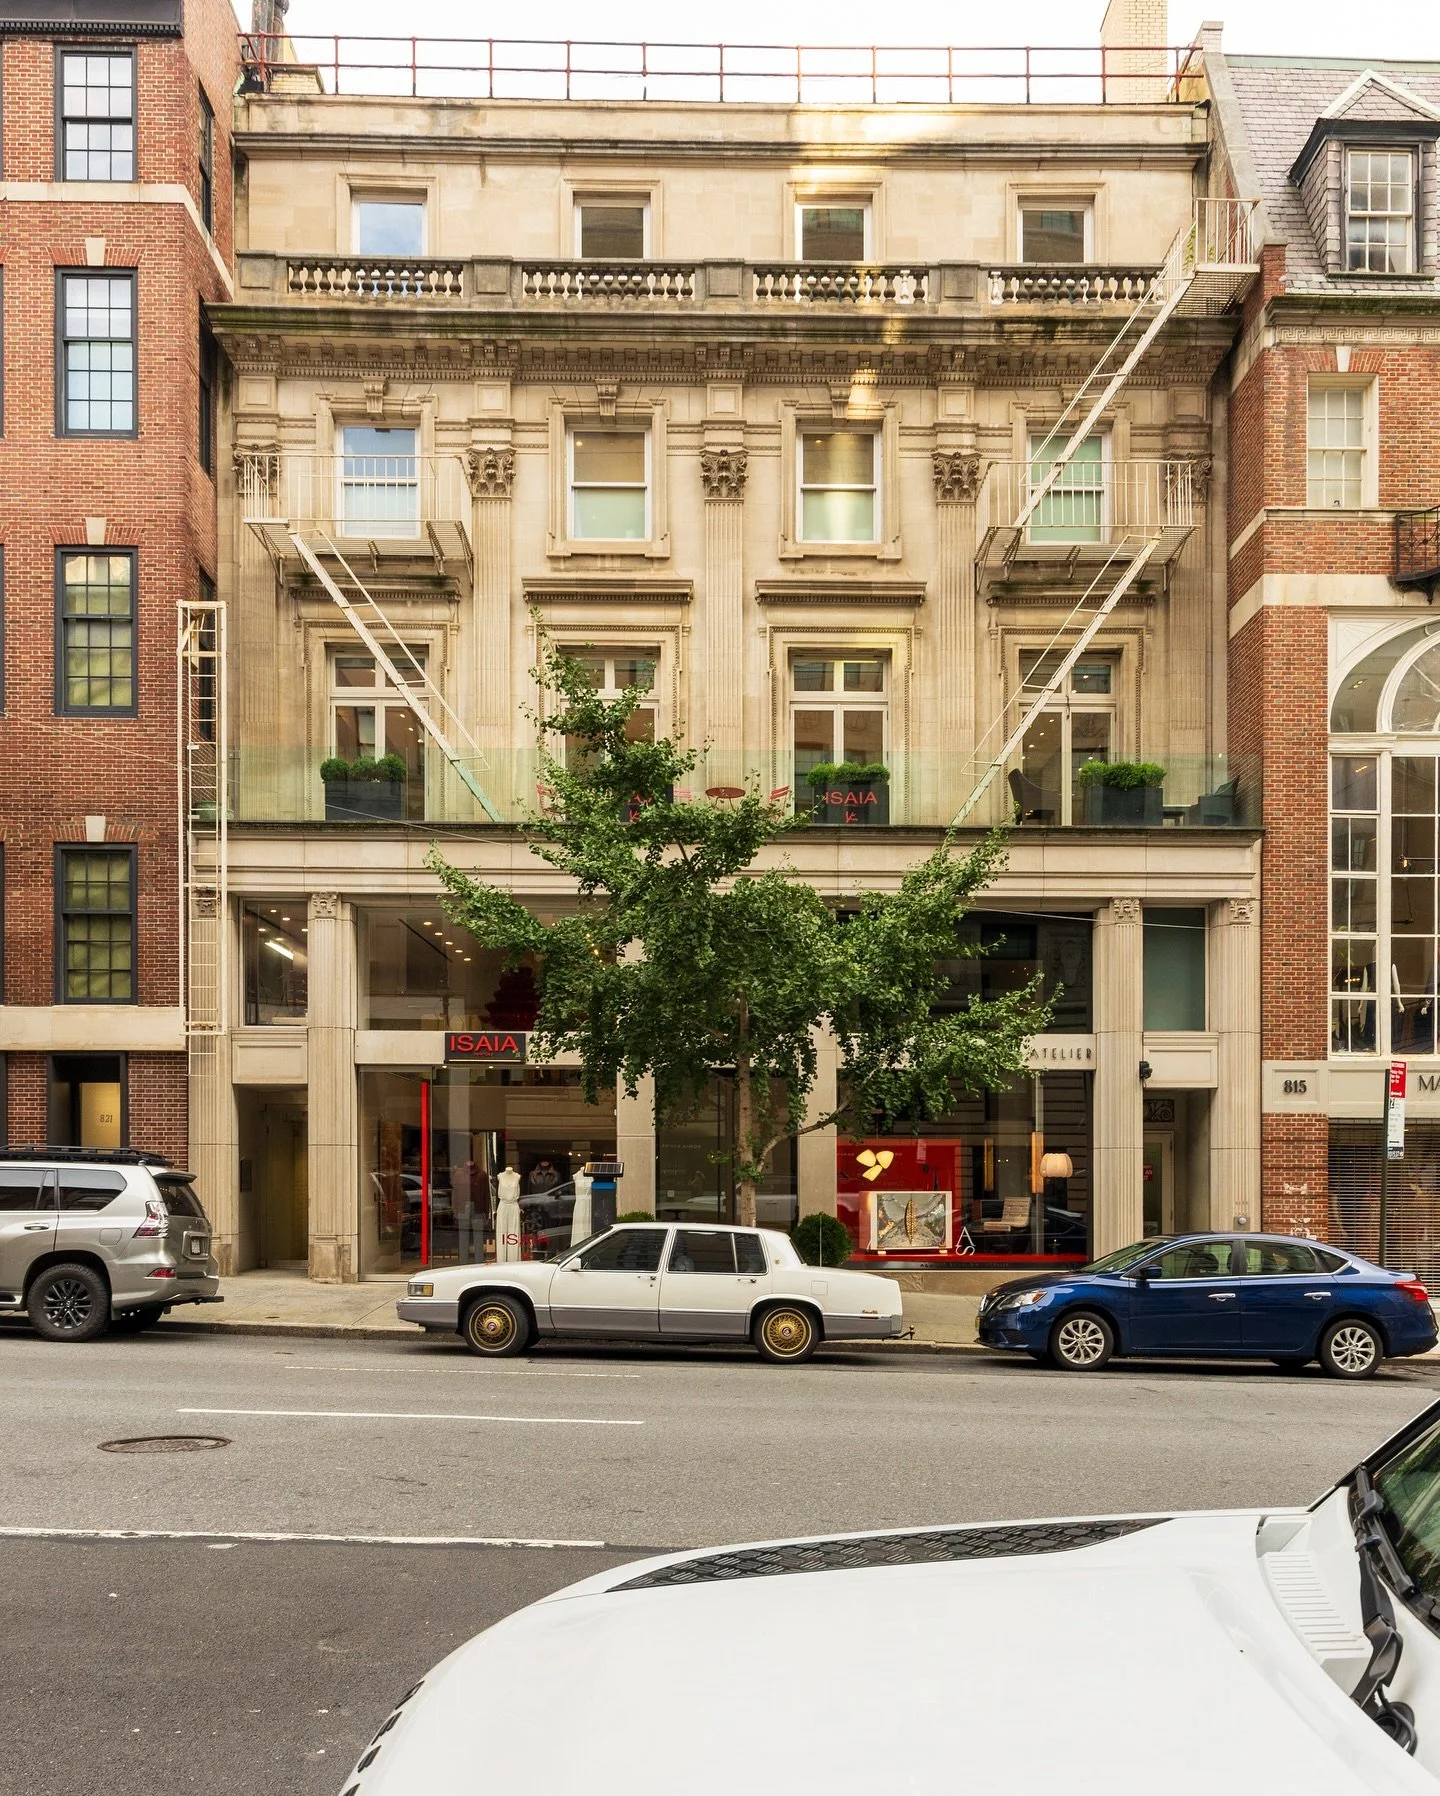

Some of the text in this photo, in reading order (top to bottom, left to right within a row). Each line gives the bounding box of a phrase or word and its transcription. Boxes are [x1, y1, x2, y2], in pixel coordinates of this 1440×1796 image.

[825, 791, 878, 805] ISAIA
[450, 1035, 519, 1053] ISAIA
[1029, 1047, 1092, 1060] ATELIER
[1283, 1079, 1307, 1094] 815
[99, 1114, 113, 1123] 821
